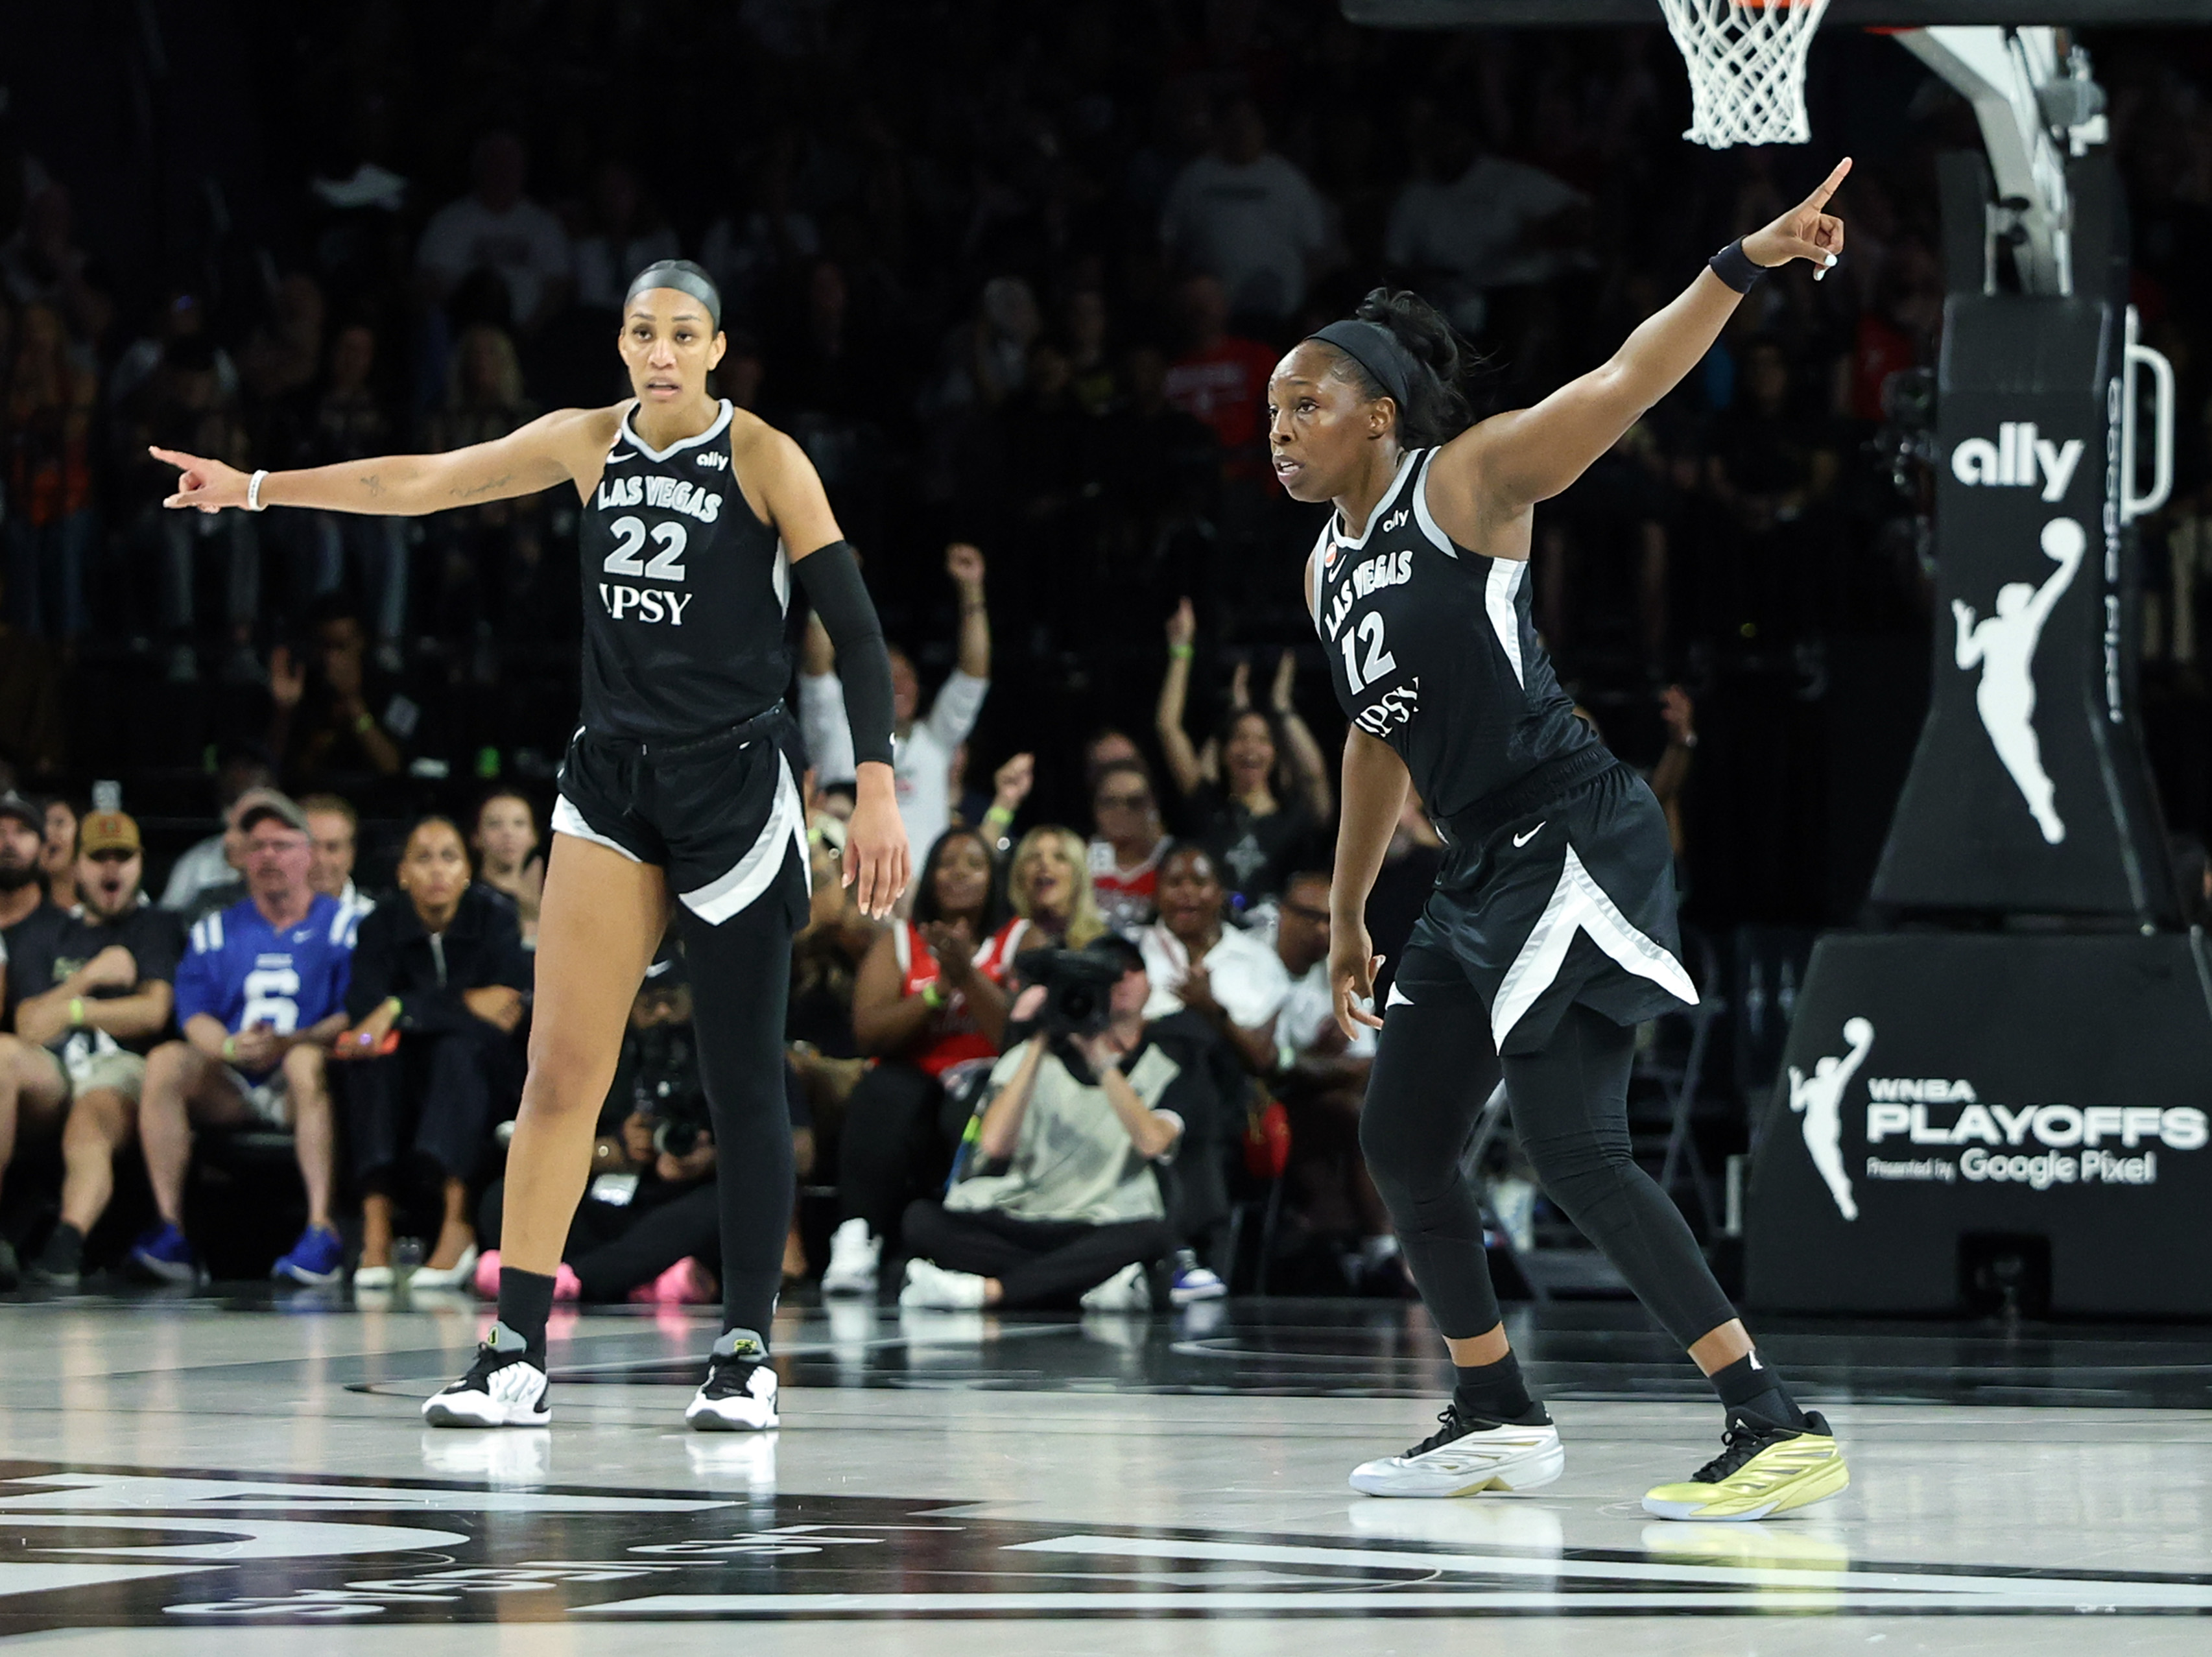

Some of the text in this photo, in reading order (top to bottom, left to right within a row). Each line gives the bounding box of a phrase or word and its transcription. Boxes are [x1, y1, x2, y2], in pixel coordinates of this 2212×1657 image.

[696, 451, 729, 471] ally
[1951, 422, 2084, 503] ally
[598, 475, 723, 523] LAS VEGAS
[604, 516, 687, 581] 22
[1324, 550, 1413, 643] LAS VEGAS
[1341, 611, 1397, 695] 12
[1868, 1078, 1977, 1103] WNBA
[1866, 1104, 2210, 1150] PLAYOFFS
[1960, 1147, 2078, 1191] Google
[2080, 1149, 2158, 1184] Pixel
